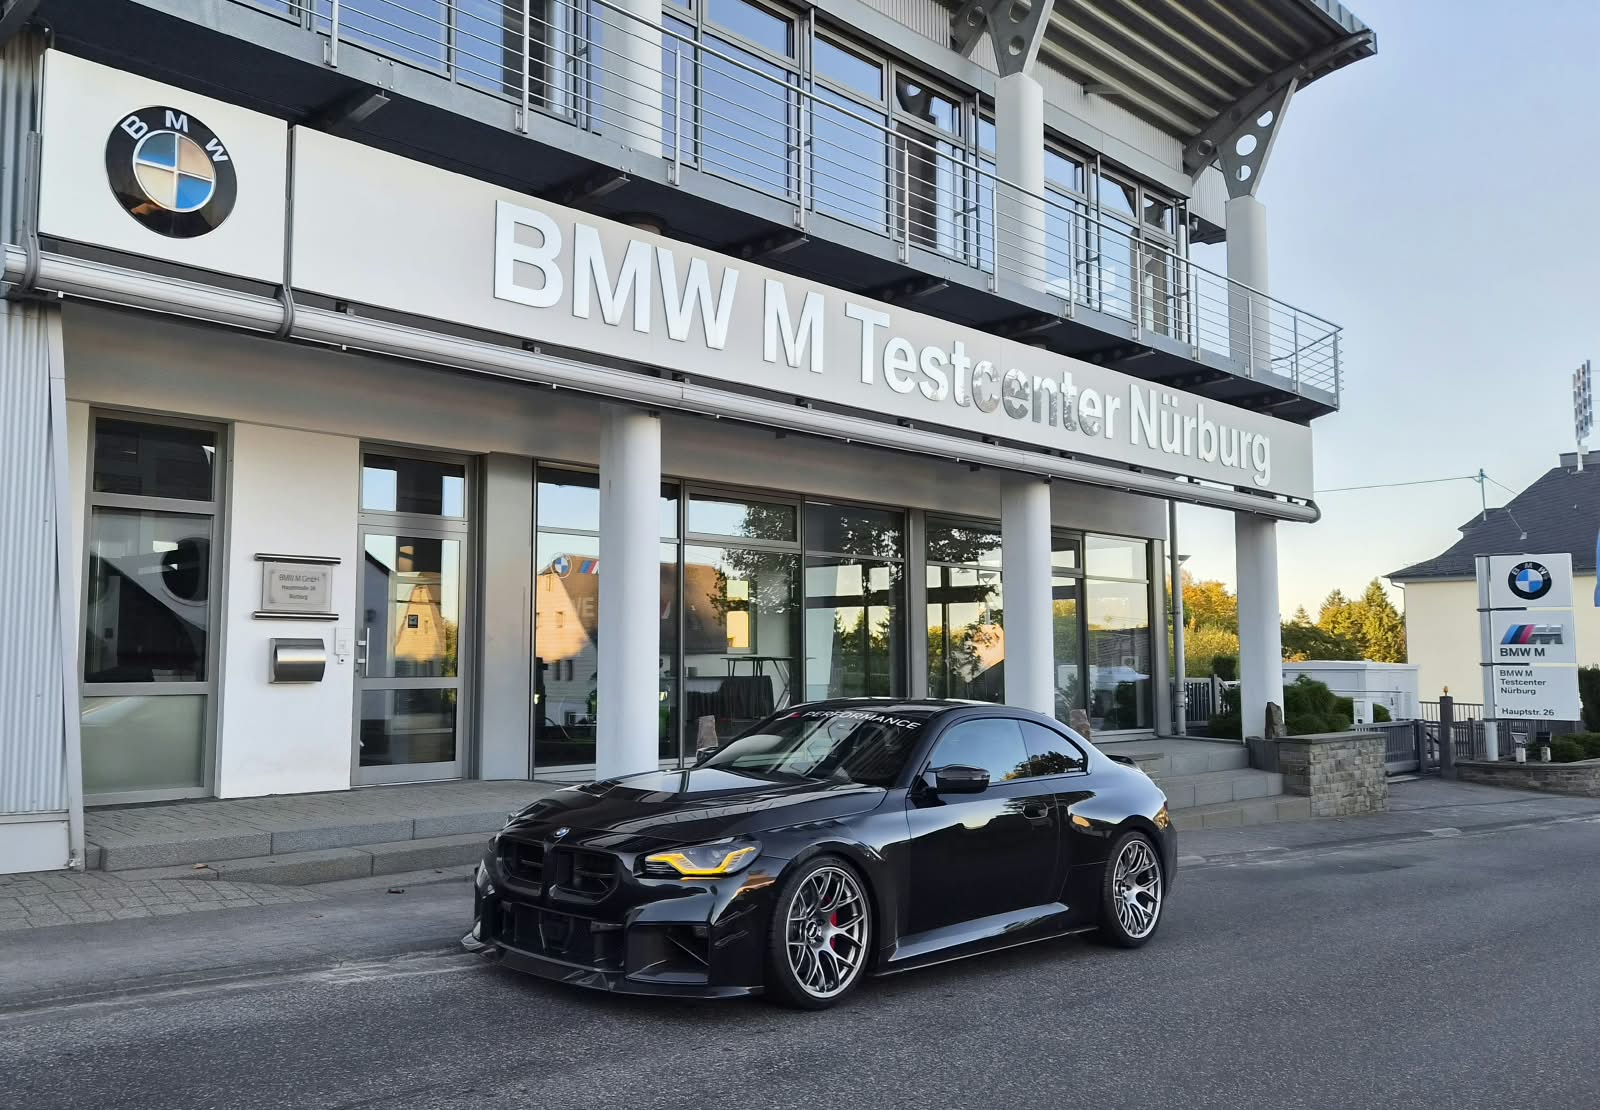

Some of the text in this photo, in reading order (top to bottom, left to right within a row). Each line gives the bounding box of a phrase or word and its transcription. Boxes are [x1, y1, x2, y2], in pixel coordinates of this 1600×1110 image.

[120, 110, 229, 162] BMW
[493, 199, 1271, 487] BMW M Testcenter Nürburg
[1511, 562, 1548, 576] BMW
[1500, 647, 1546, 657] BMW M
[1500, 669, 1533, 677] BMW M
[1500, 678, 1547, 687] Testcenter
[1501, 687, 1537, 696] Nürburg
[1502, 708, 1555, 717] Hauptstr. 26
[802, 710, 922, 730] PERFORMANCE
